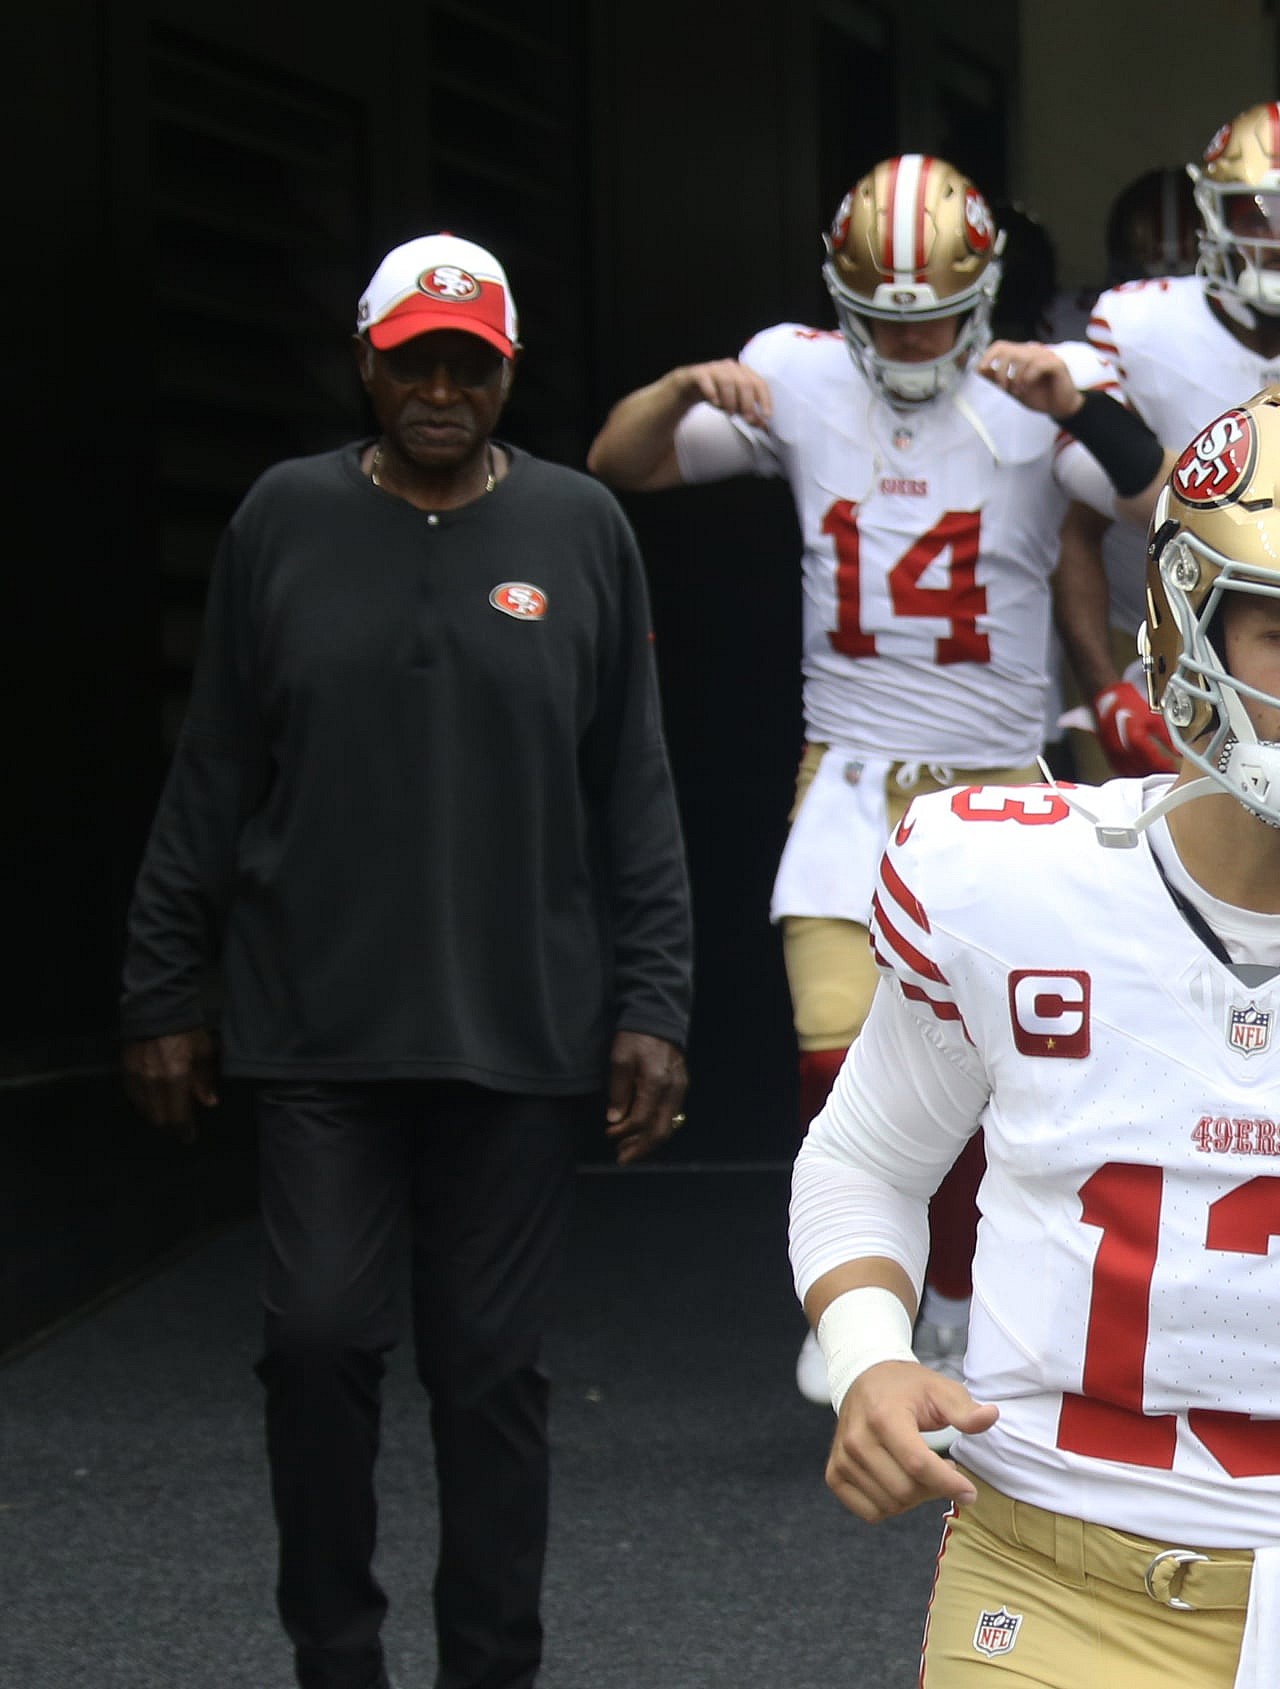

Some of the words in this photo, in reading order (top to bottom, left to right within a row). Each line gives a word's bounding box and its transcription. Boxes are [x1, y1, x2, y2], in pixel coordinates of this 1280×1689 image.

[821, 500, 992, 665] 14
[1015, 976, 1085, 1036] C
[1233, 1025, 1264, 1048] NFL
[977, 1627, 1008, 1650] NFL
